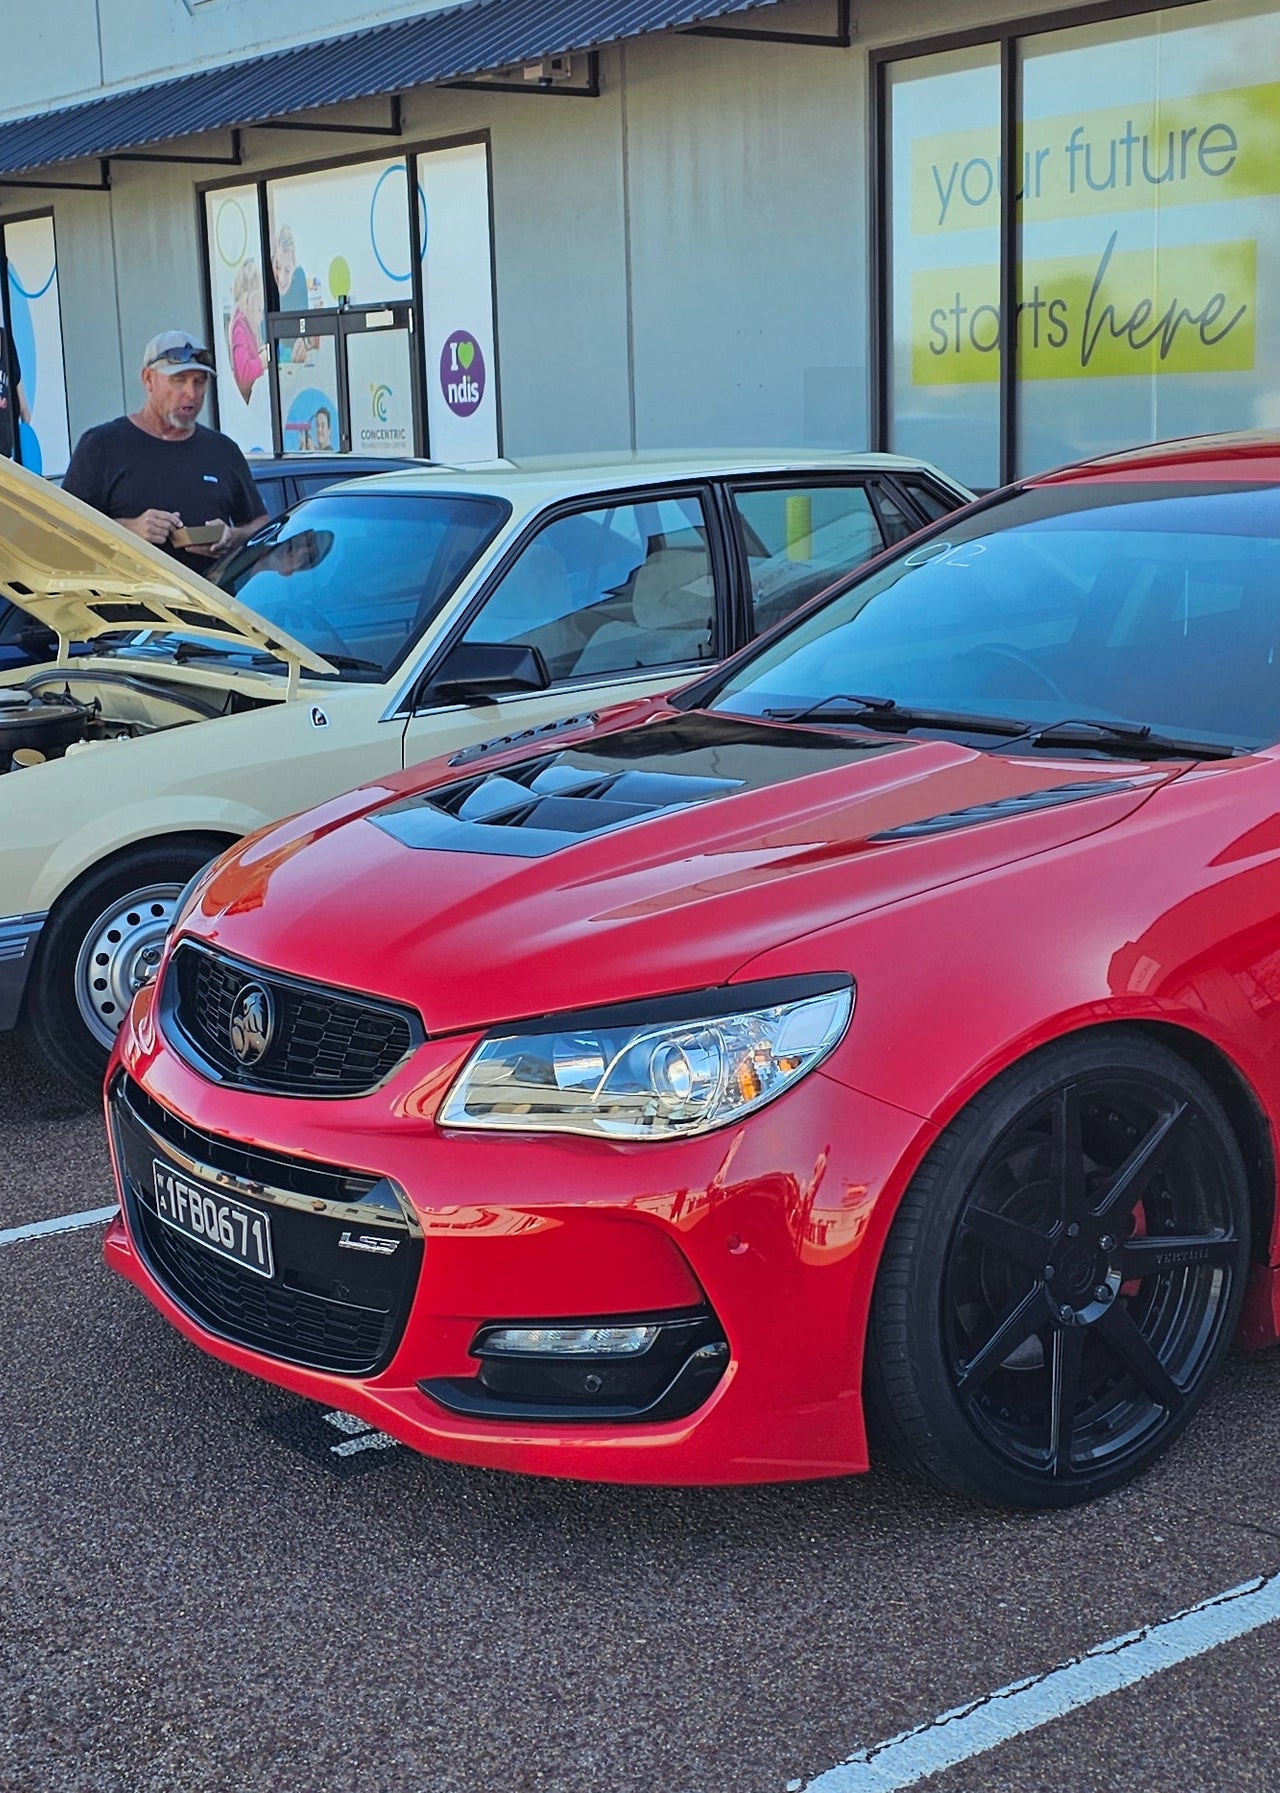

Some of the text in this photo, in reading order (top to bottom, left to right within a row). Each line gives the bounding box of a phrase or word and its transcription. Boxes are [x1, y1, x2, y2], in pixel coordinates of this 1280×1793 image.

[931, 120, 1238, 226] your future
[929, 230, 1247, 367] starts here
[449, 342, 459, 371] I
[448, 375, 480, 404] ndis
[360, 428, 406, 441] CONCENTRIC
[166, 1176, 265, 1265] 1FBQ671
